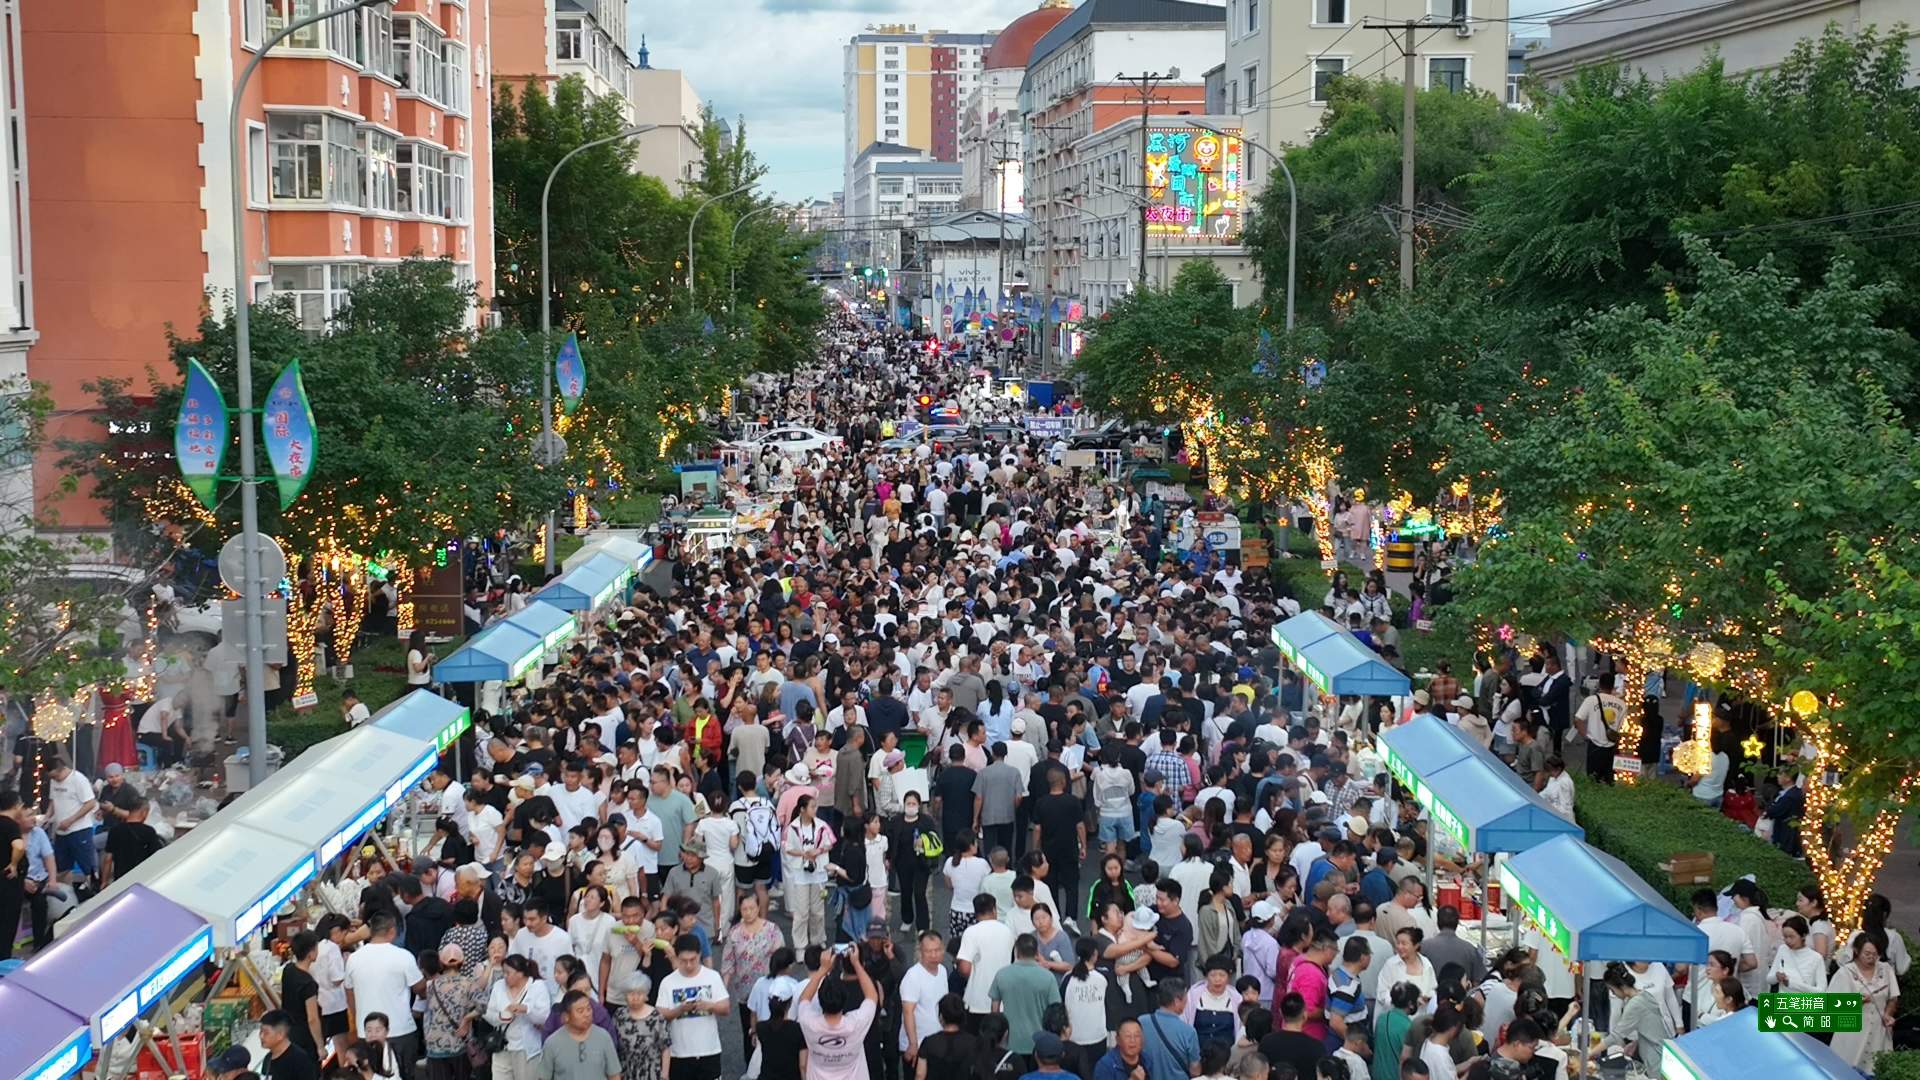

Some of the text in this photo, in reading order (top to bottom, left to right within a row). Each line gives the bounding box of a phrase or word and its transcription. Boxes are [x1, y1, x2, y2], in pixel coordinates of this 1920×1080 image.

[1145, 206, 1192, 222] 大夜市
[959, 267, 981, 275] vivo
[288, 439, 305, 477] 大夜市
